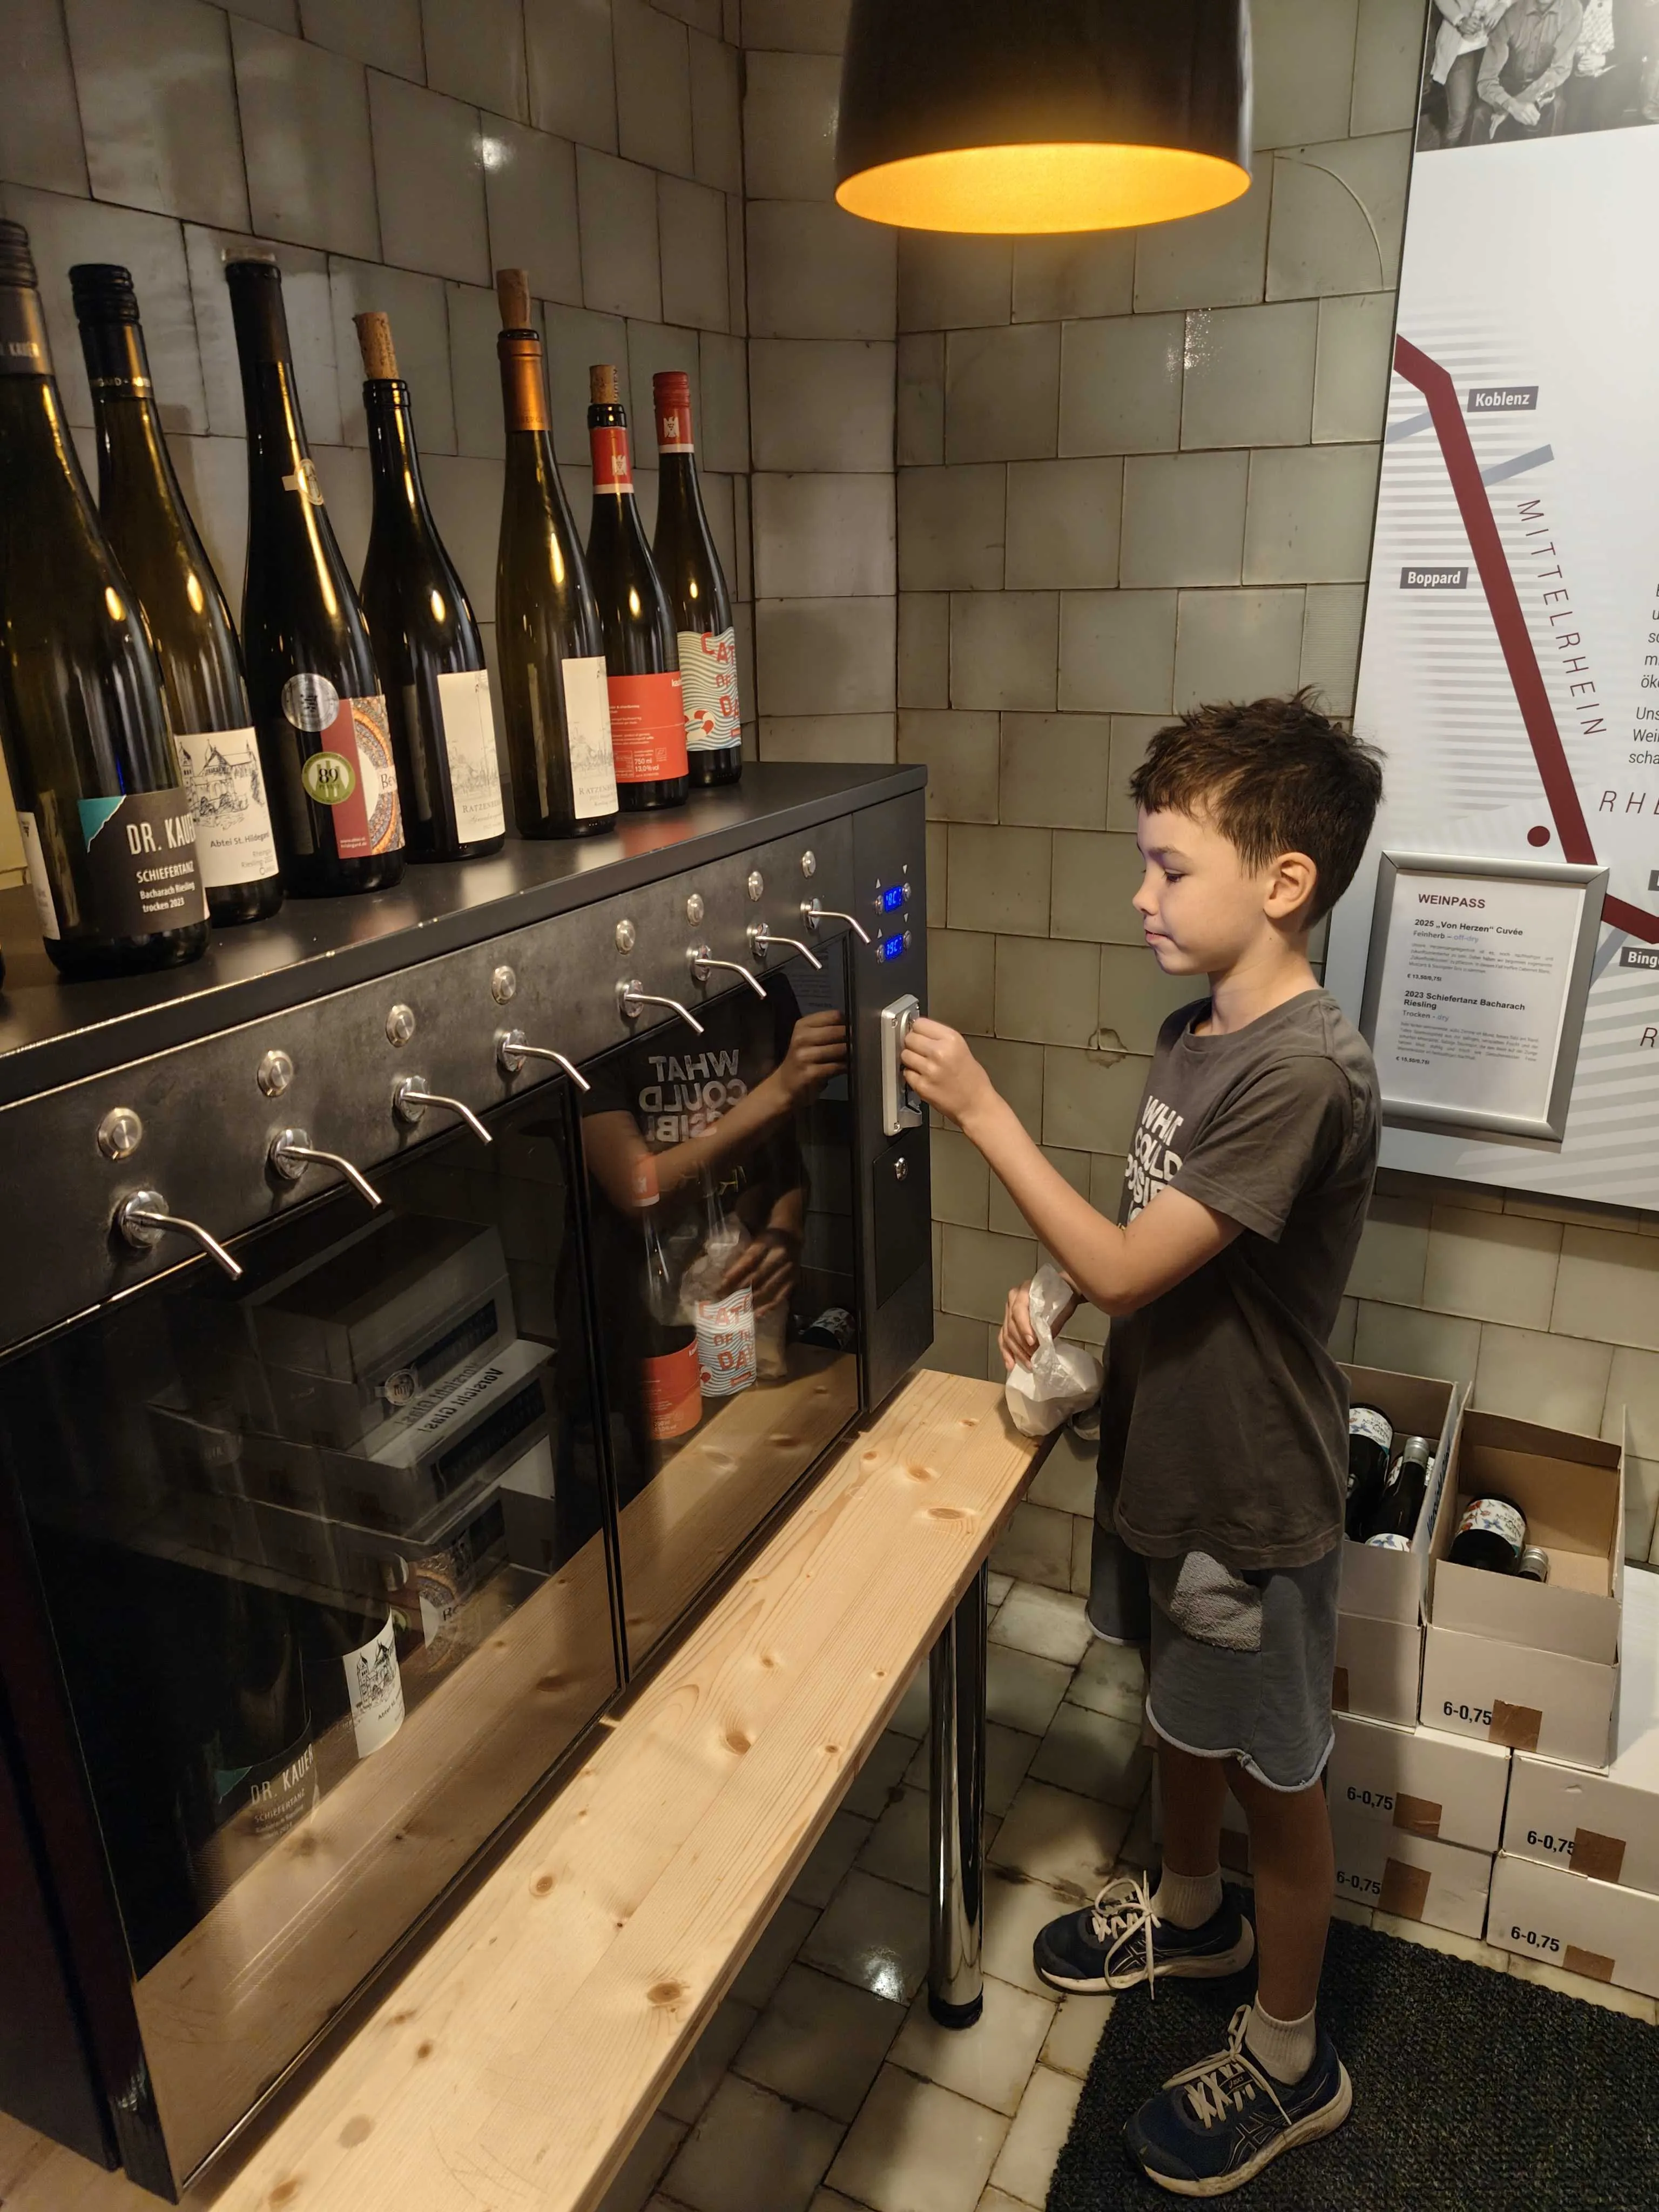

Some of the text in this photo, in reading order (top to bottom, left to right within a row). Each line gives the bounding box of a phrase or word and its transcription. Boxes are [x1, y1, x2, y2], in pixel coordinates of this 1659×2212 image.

[1475, 393, 1530, 407] Koblenz
[1407, 571, 1461, 587] Boppard
[1517, 500, 1607, 734] MITTELRHEIN
[319, 768, 338, 783] 89
[126, 823, 162, 855] DR.
[211, 838, 232, 848] Abtei
[234, 837, 243, 845] St.
[136, 860, 194, 884] SCHIEFERTANZ
[140, 886, 176, 900] Bacharach
[1418, 894, 1486, 909] WEINPASS
[142, 902, 169, 913] trocken
[1413, 930, 1445, 939] Feinherb
[1459, 923, 1494, 933] Herzen“
[1496, 927, 1523, 935] Cuvée
[1404, 999, 1437, 1010] Riesling
[1405, 990, 1526, 1010] 2023 Schiefertanz Bacharach
[1402, 1010, 1431, 1019] Trocken
[1134, 1127, 1183, 1181] COULD
[1443, 1701, 1492, 1725] 6-0,75
[251, 1743, 314, 1804] DR. KAUER
[254, 1788, 305, 1823] SCHIEFERTANZ
[1346, 1786, 1393, 1811] 6-0,75
[1337, 1871, 1382, 1895] 6-0,75
[1511, 1926, 1560, 1952] 6-0,75
